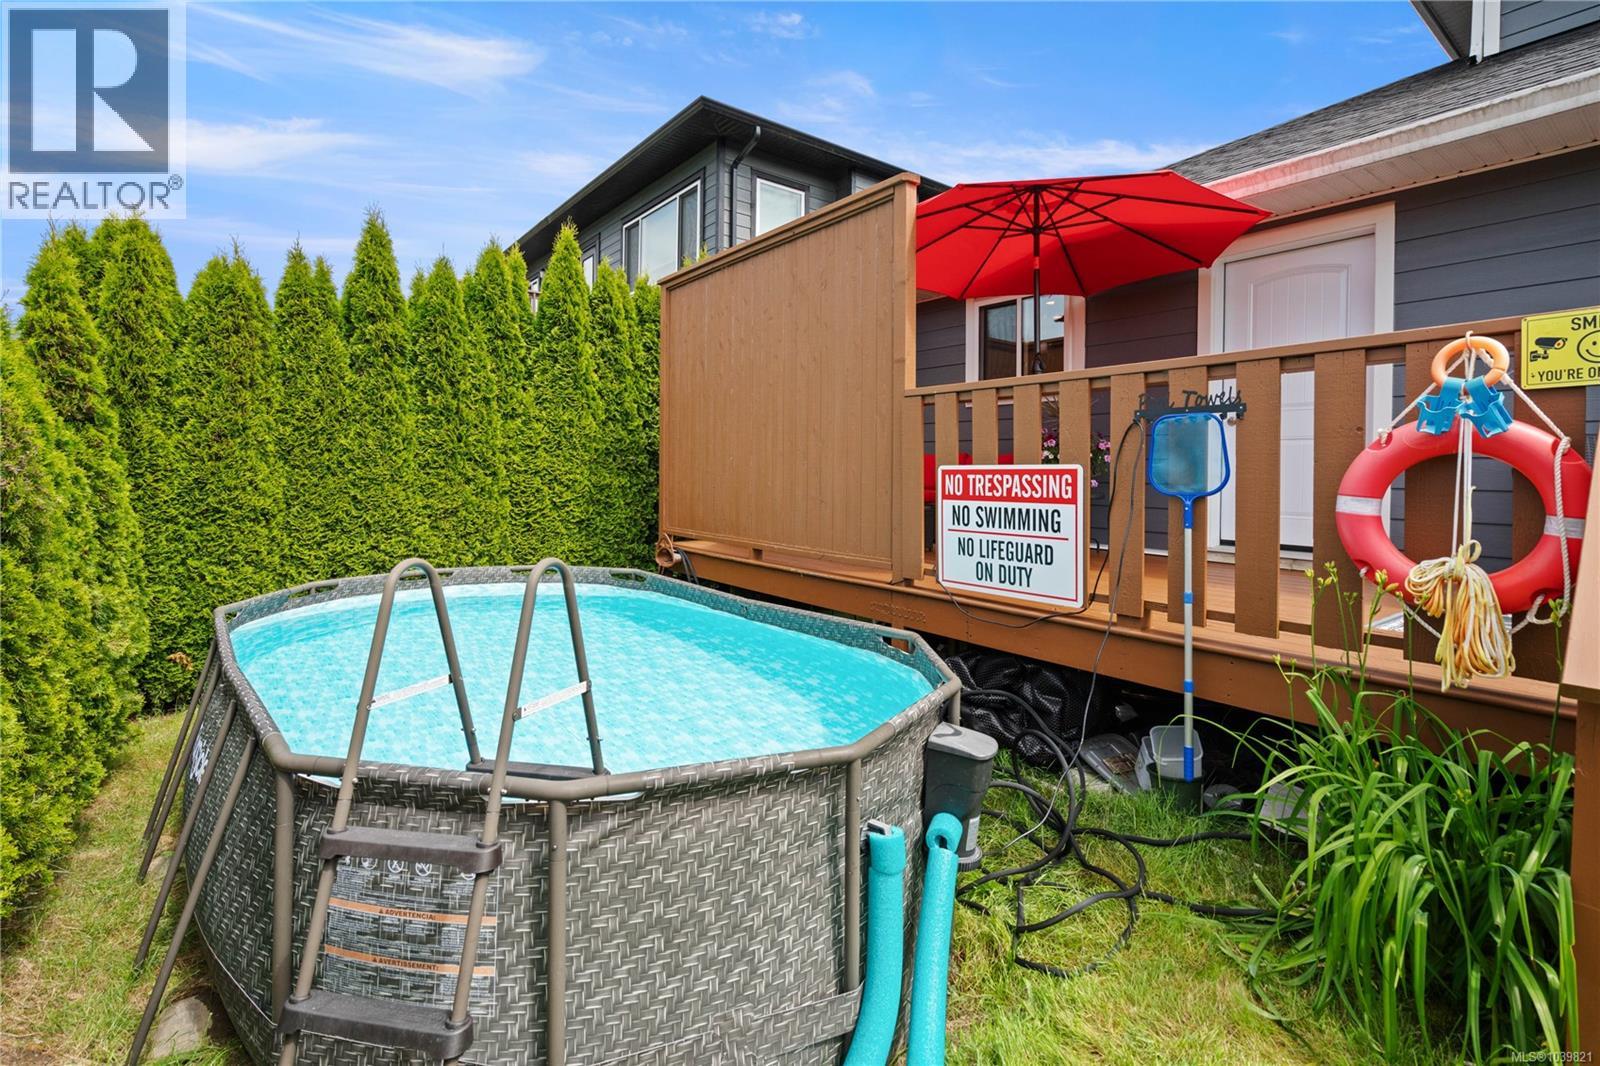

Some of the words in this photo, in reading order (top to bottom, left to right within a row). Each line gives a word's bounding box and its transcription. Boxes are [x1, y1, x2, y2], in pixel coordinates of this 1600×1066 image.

[1538, 368, 1584, 382] YOU'RE
[944, 474, 963, 496] NO
[967, 474, 1073, 499] TRESPASSING
[952, 505, 970, 527] NO
[975, 506, 1061, 534] SWIMMING
[957, 537, 974, 557] NO
[979, 538, 1054, 566] LIFEGUARD
[975, 561, 993, 583] ON
[998, 564, 1033, 588] DUTY
